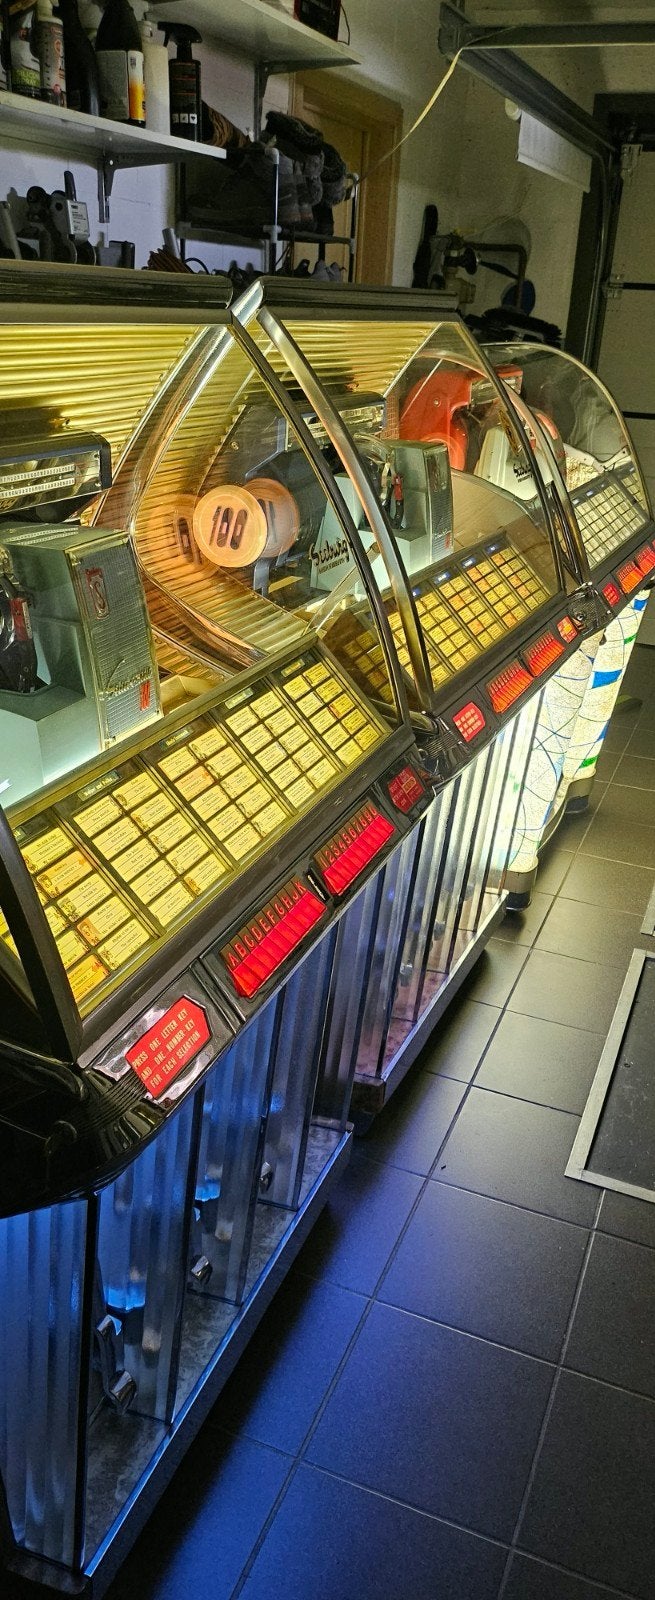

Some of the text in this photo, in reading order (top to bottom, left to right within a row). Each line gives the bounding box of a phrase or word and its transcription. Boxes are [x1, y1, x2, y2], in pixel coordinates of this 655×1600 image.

[132, 1009, 188, 1069] PRESS ONE LETTER KEY
[141, 1018, 195, 1080] AND ONE NUMBER KEY
[150, 1030, 201, 1088] FOR EACH SELECTION
